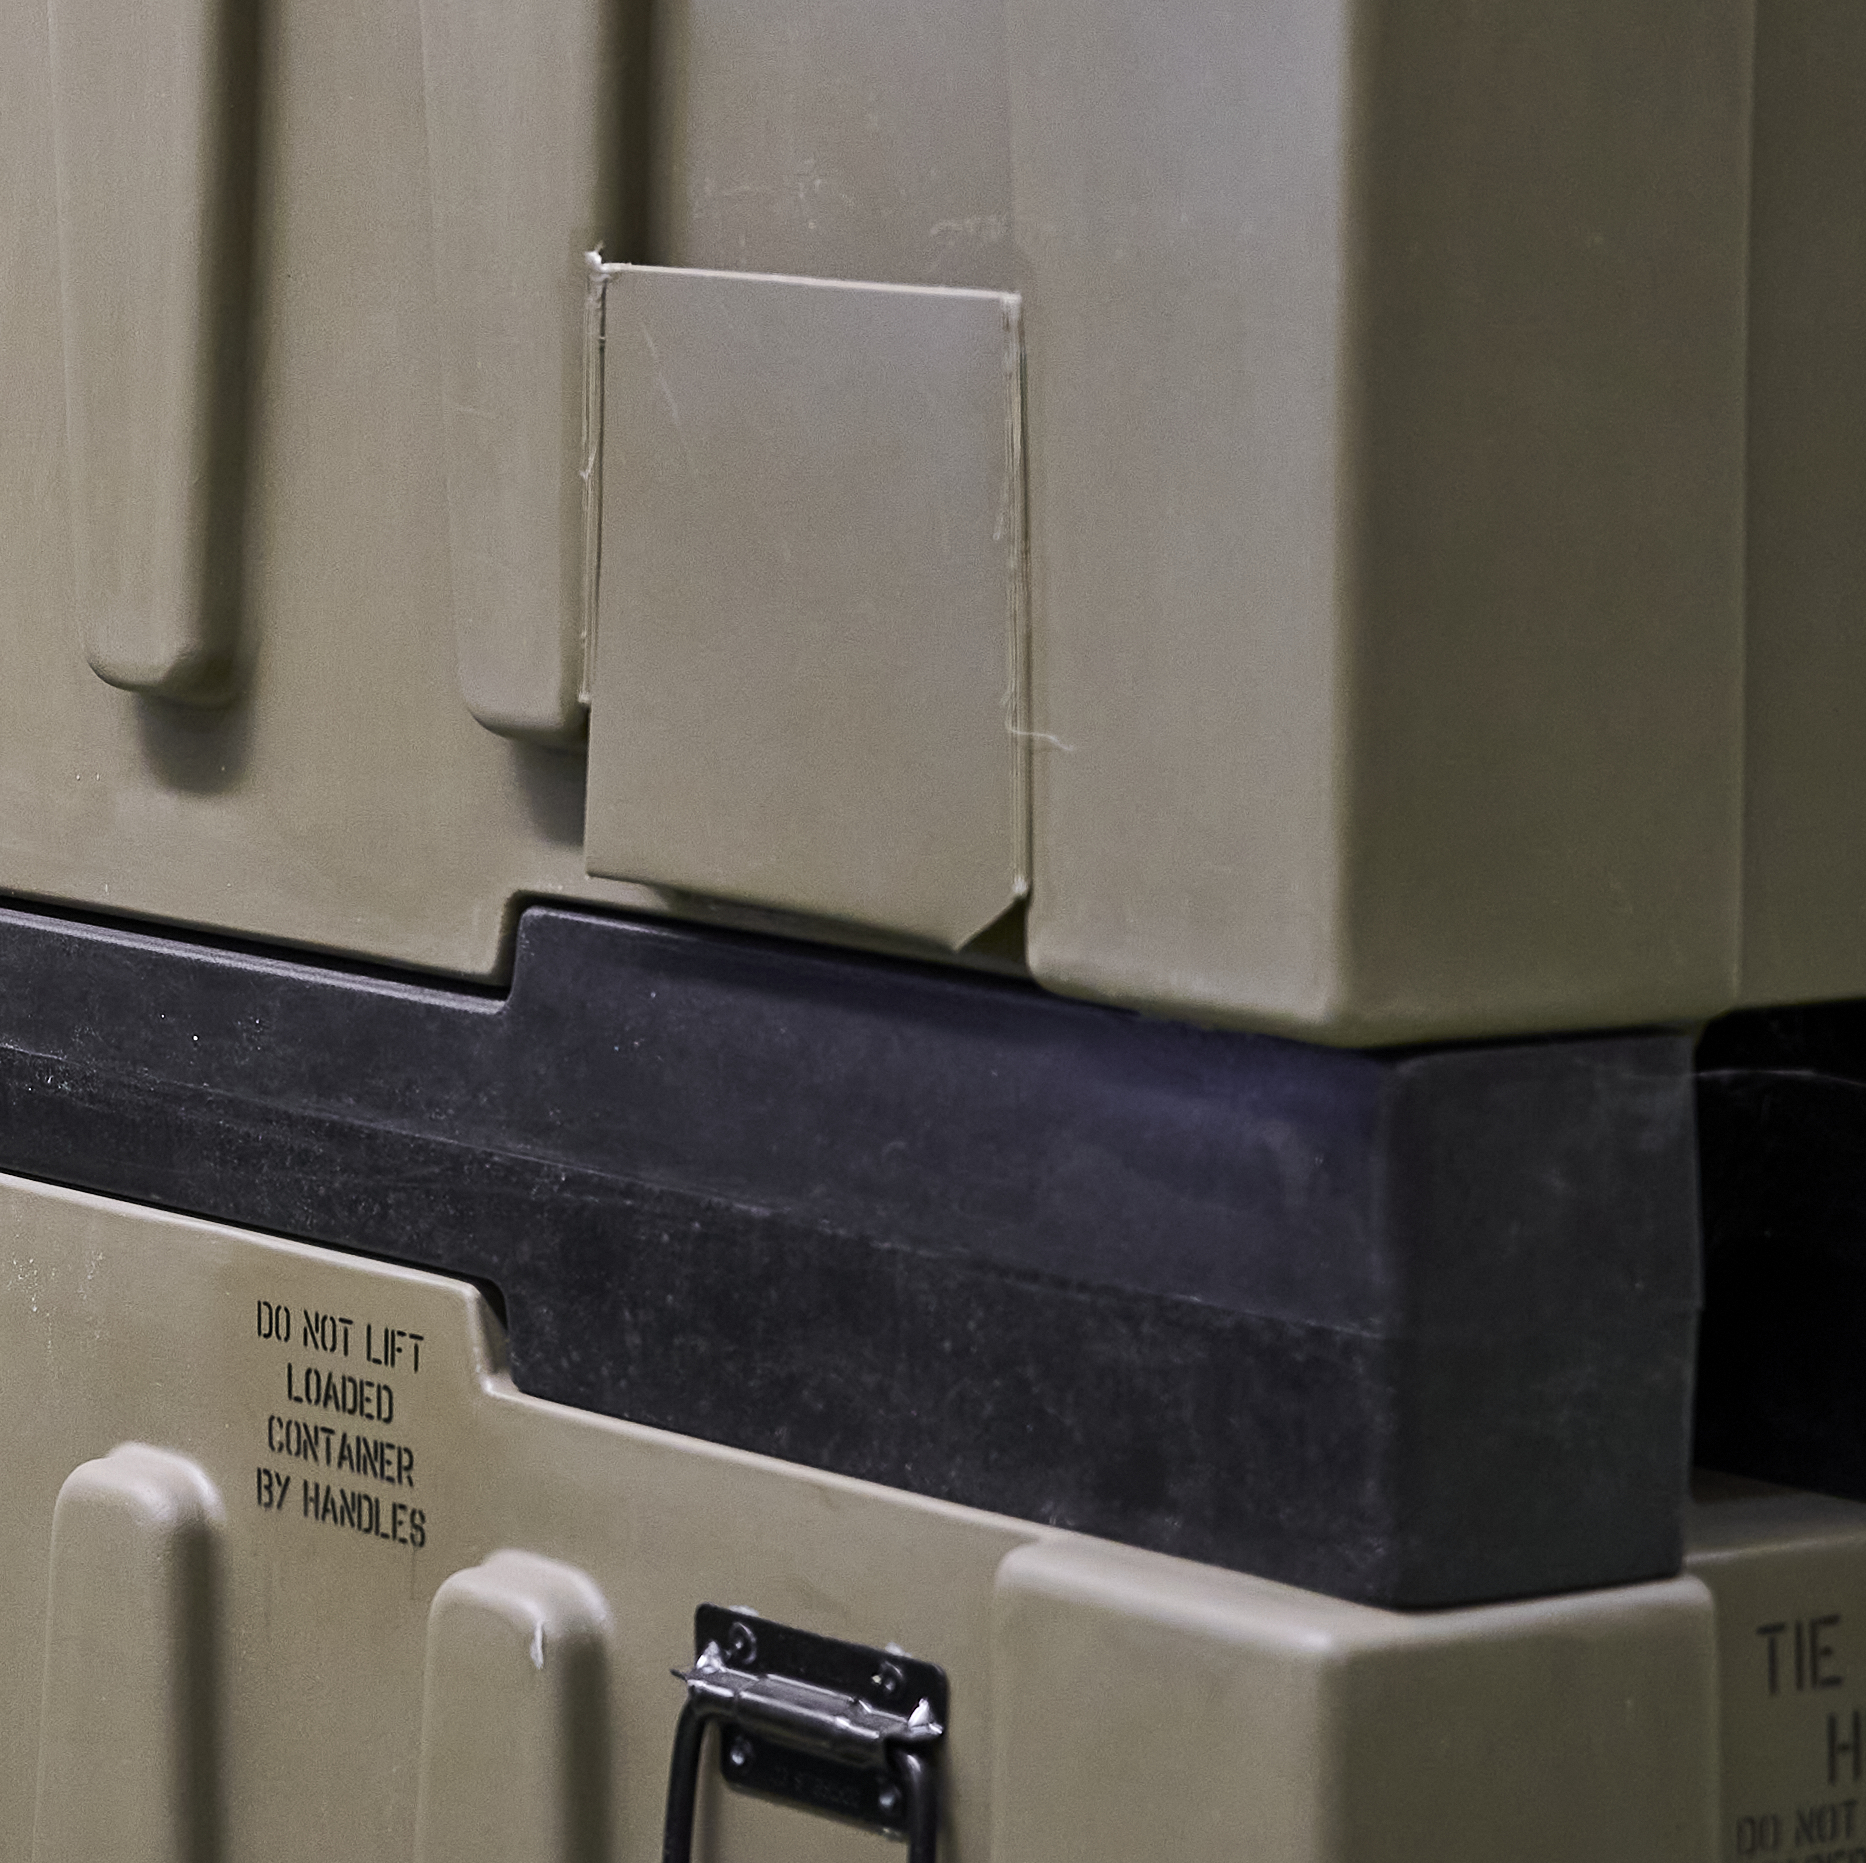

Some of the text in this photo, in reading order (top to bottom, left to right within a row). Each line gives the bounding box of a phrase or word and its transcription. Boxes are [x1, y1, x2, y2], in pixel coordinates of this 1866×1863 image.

[256, 1299, 424, 1373] DO NOT LIFT
[287, 1362, 394, 1424] LOADED
[267, 1415, 415, 1487] CONTAINER
[256, 1466, 426, 1548] BY HANDLES
[1756, 1613, 1844, 1696] TIE
[1736, 1798, 1857, 1856] DO NOT
